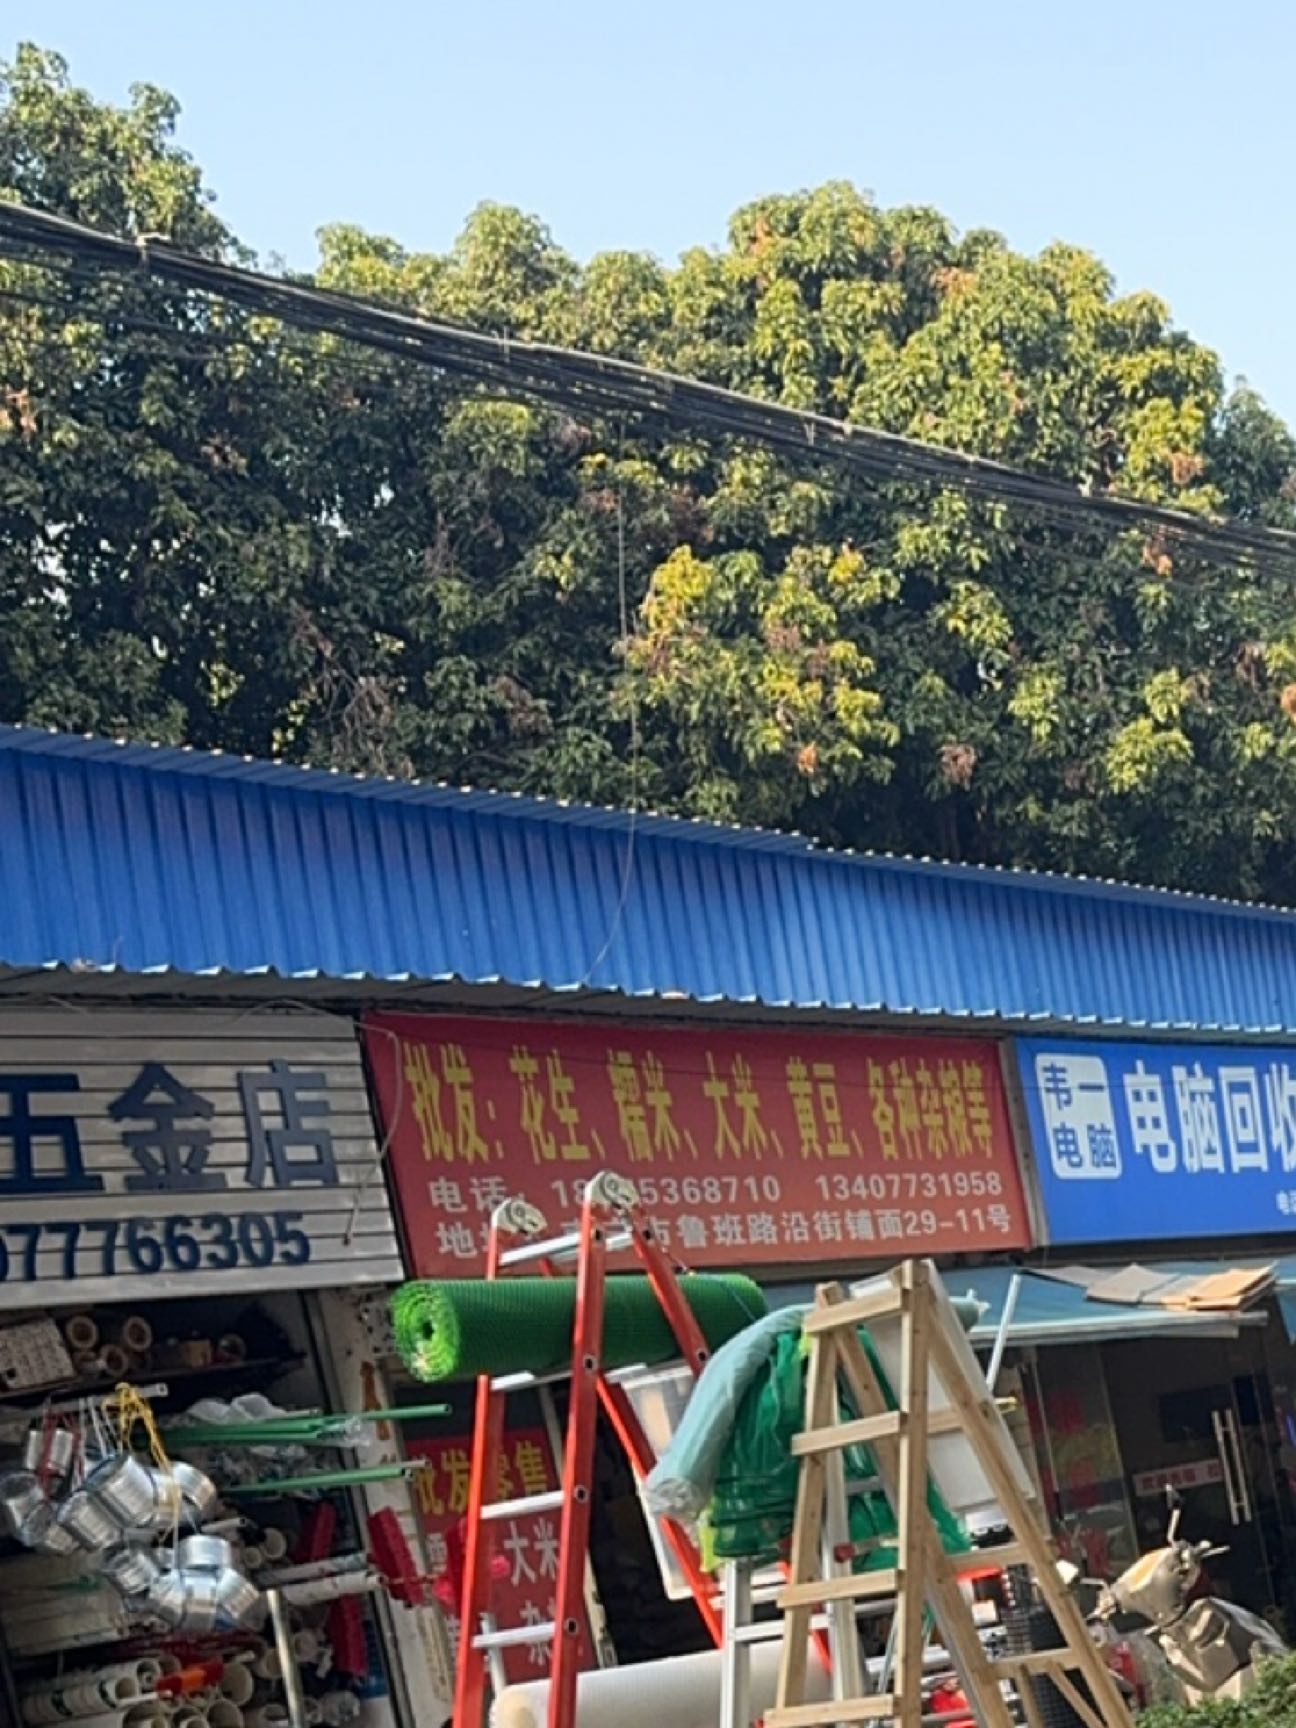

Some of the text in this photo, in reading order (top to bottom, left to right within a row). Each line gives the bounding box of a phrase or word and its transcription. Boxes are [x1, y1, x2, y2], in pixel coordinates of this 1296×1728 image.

[0, 1058, 339, 1191] 五金店
[1052, 1123, 1117, 1168] 电脑
[551, 1173, 781, 1209] 185368710
[815, 1170, 1002, 1201] 13407731958
[0, 1210, 311, 1282] 77766305
